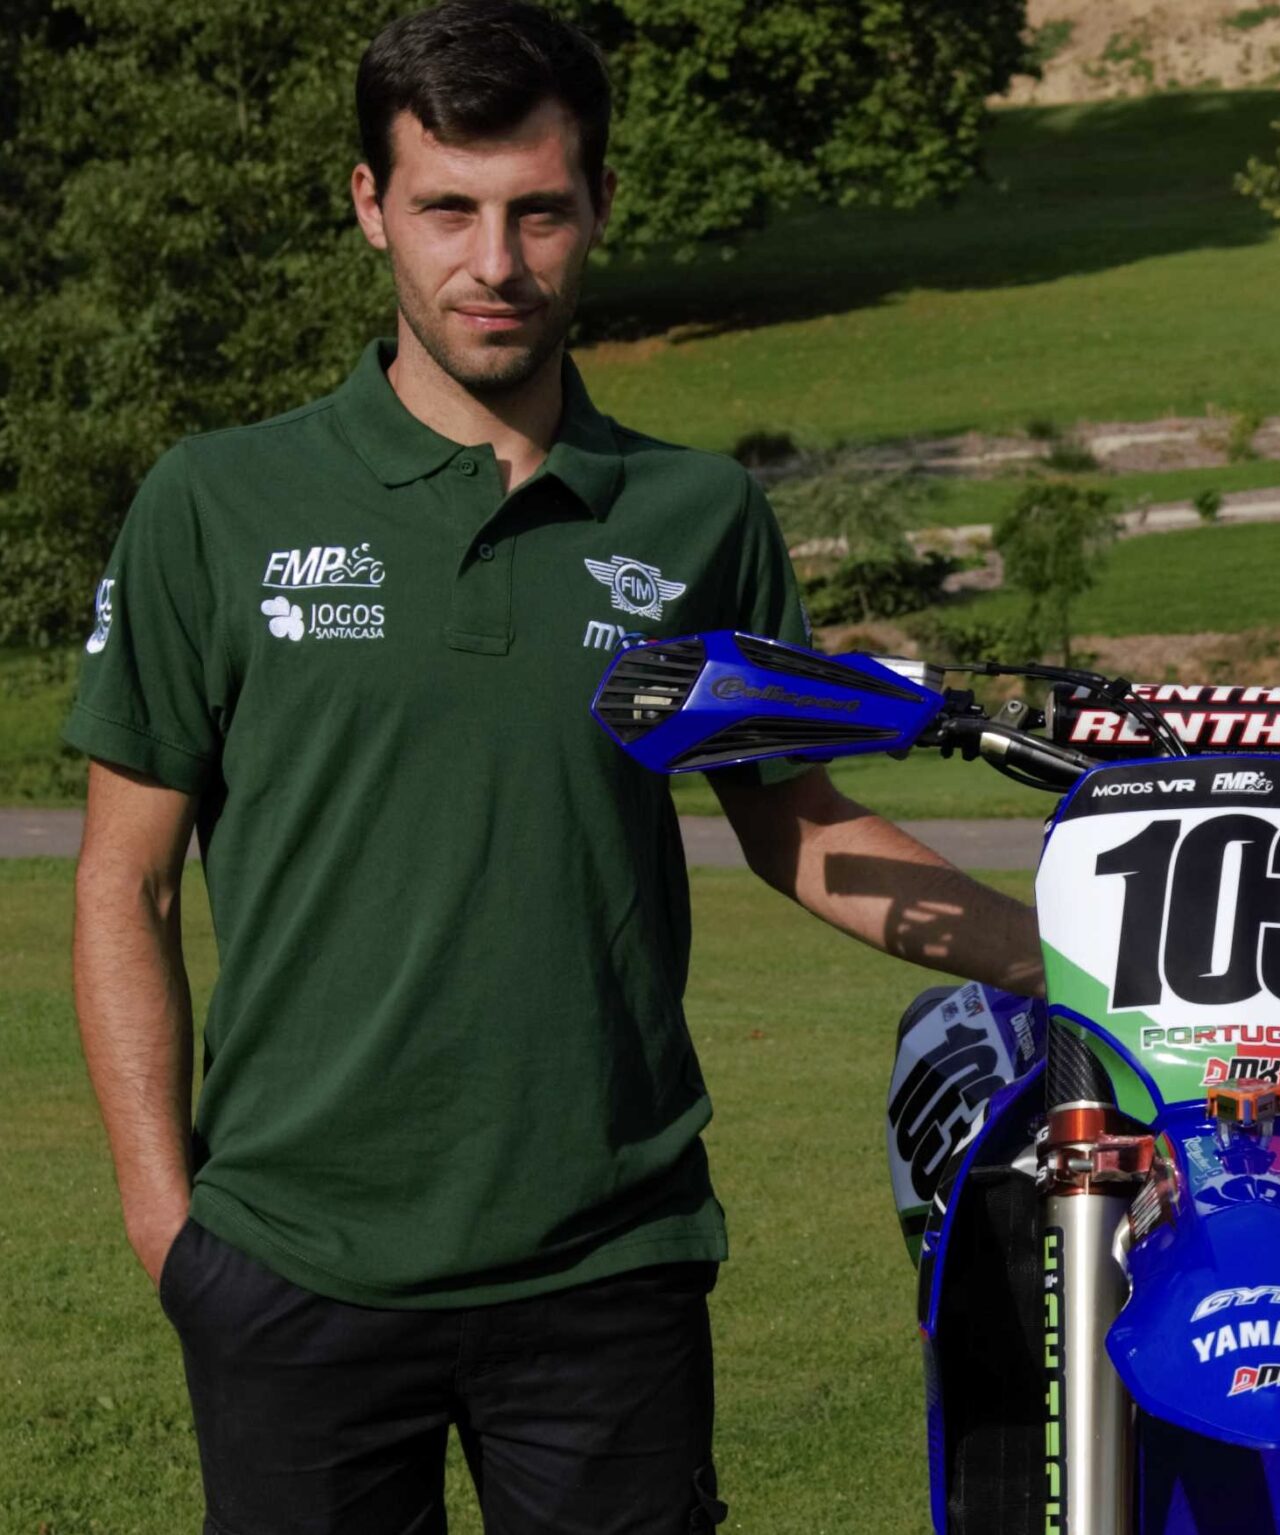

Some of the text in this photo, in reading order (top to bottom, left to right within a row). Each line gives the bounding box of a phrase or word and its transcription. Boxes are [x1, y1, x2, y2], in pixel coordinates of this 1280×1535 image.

[264, 547, 346, 586] FMP
[617, 572, 653, 601] FIM
[309, 603, 385, 634] JOGOS
[1091, 778, 1197, 798] MOTOS VR
[1210, 771, 1257, 795] FMP
